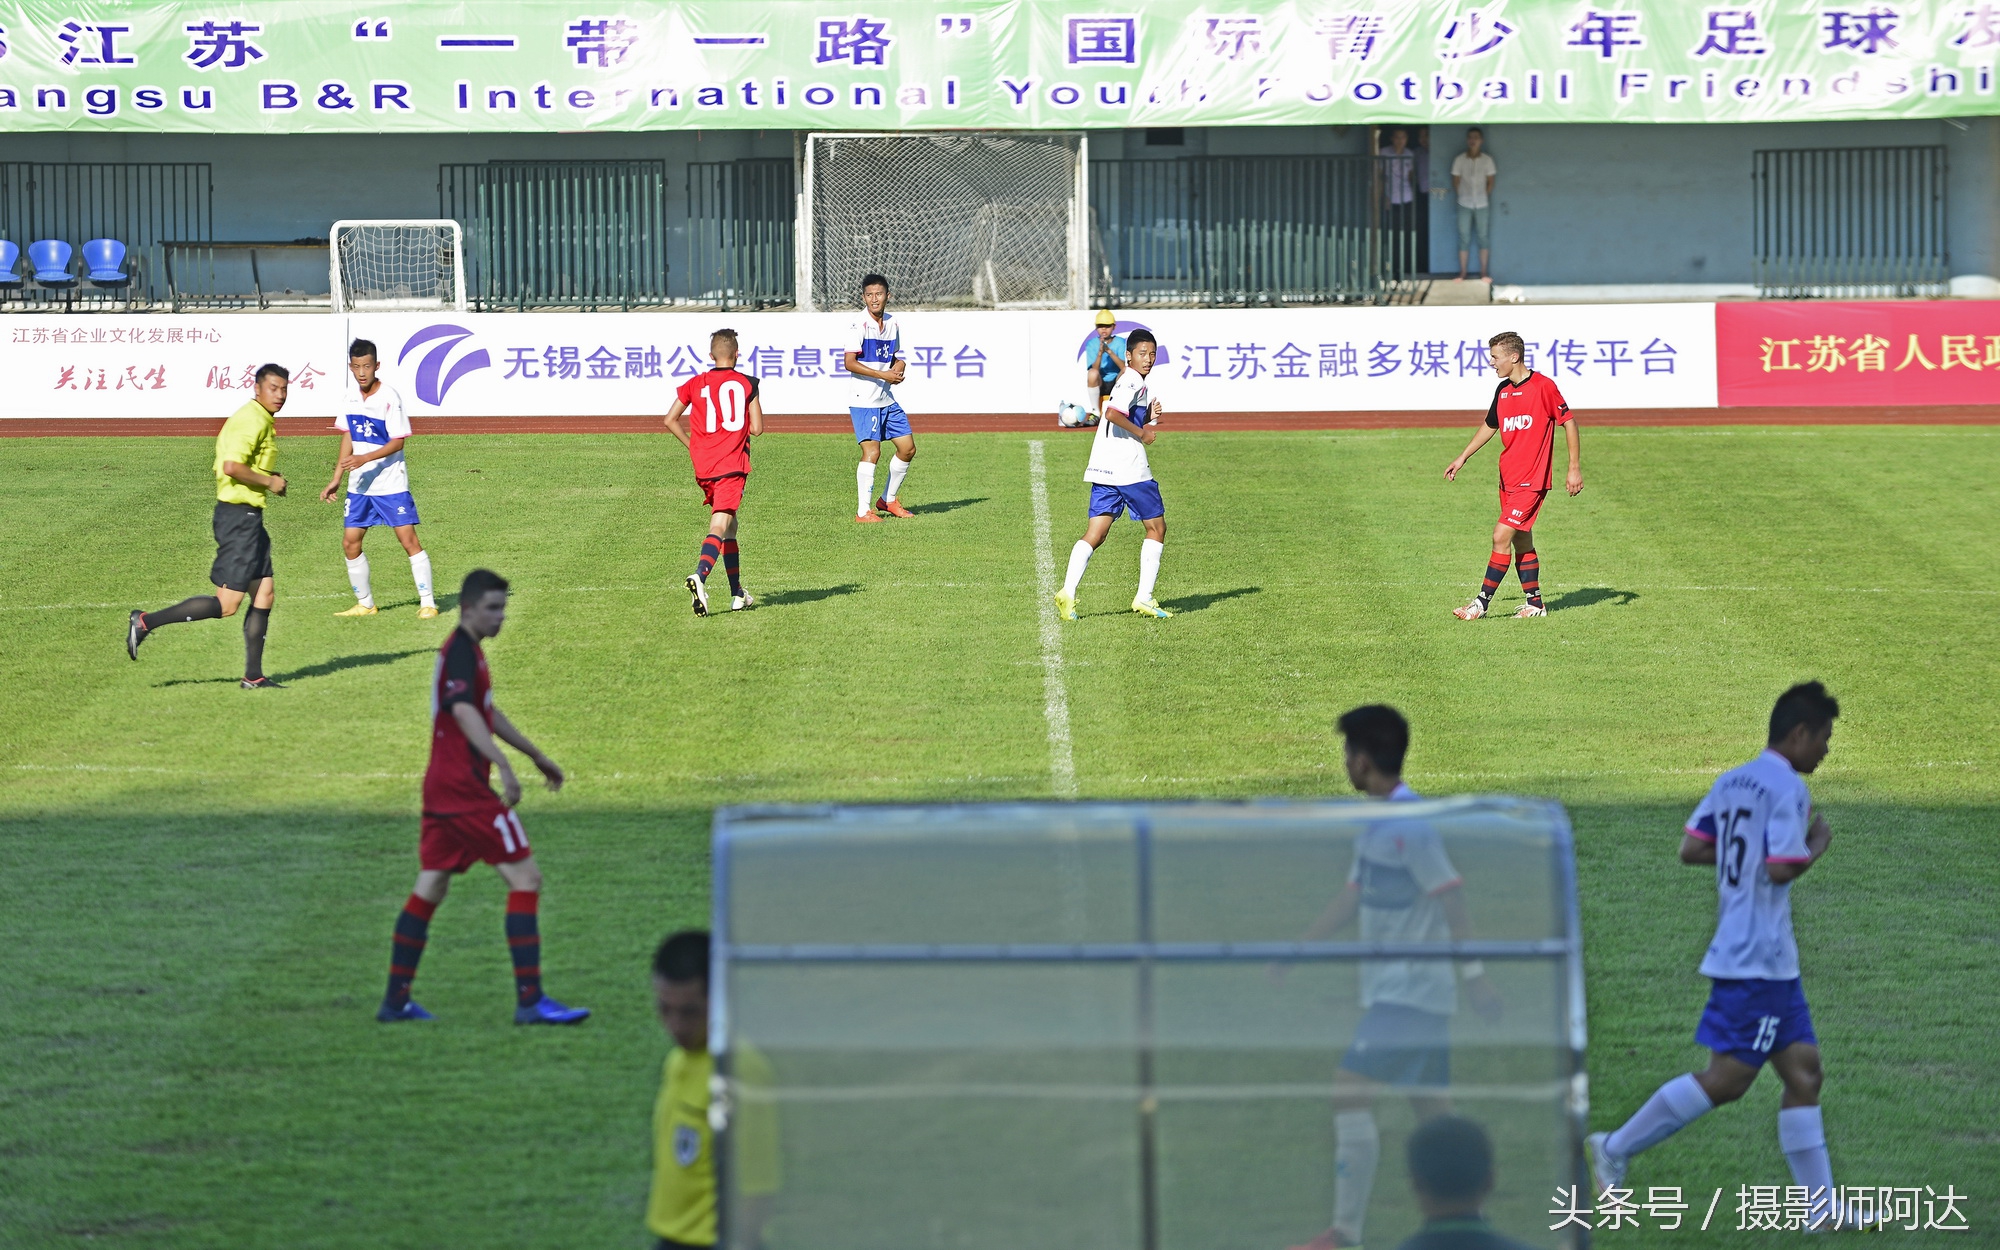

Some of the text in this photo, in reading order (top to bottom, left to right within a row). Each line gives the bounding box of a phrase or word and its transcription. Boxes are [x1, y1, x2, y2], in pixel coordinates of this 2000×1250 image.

[262, 83, 411, 109] B&R
[458, 78, 955, 109] International
[12, 326, 222, 344] 江苏省企业文化发展中心
[53, 362, 326, 391] 关注民生 服务会
[700, 380, 746, 433] 10
[871, 415, 878, 432] 2
[493, 809, 529, 853] 11
[1719, 807, 1751, 887] 15
[1752, 1015, 1780, 1052] 15
